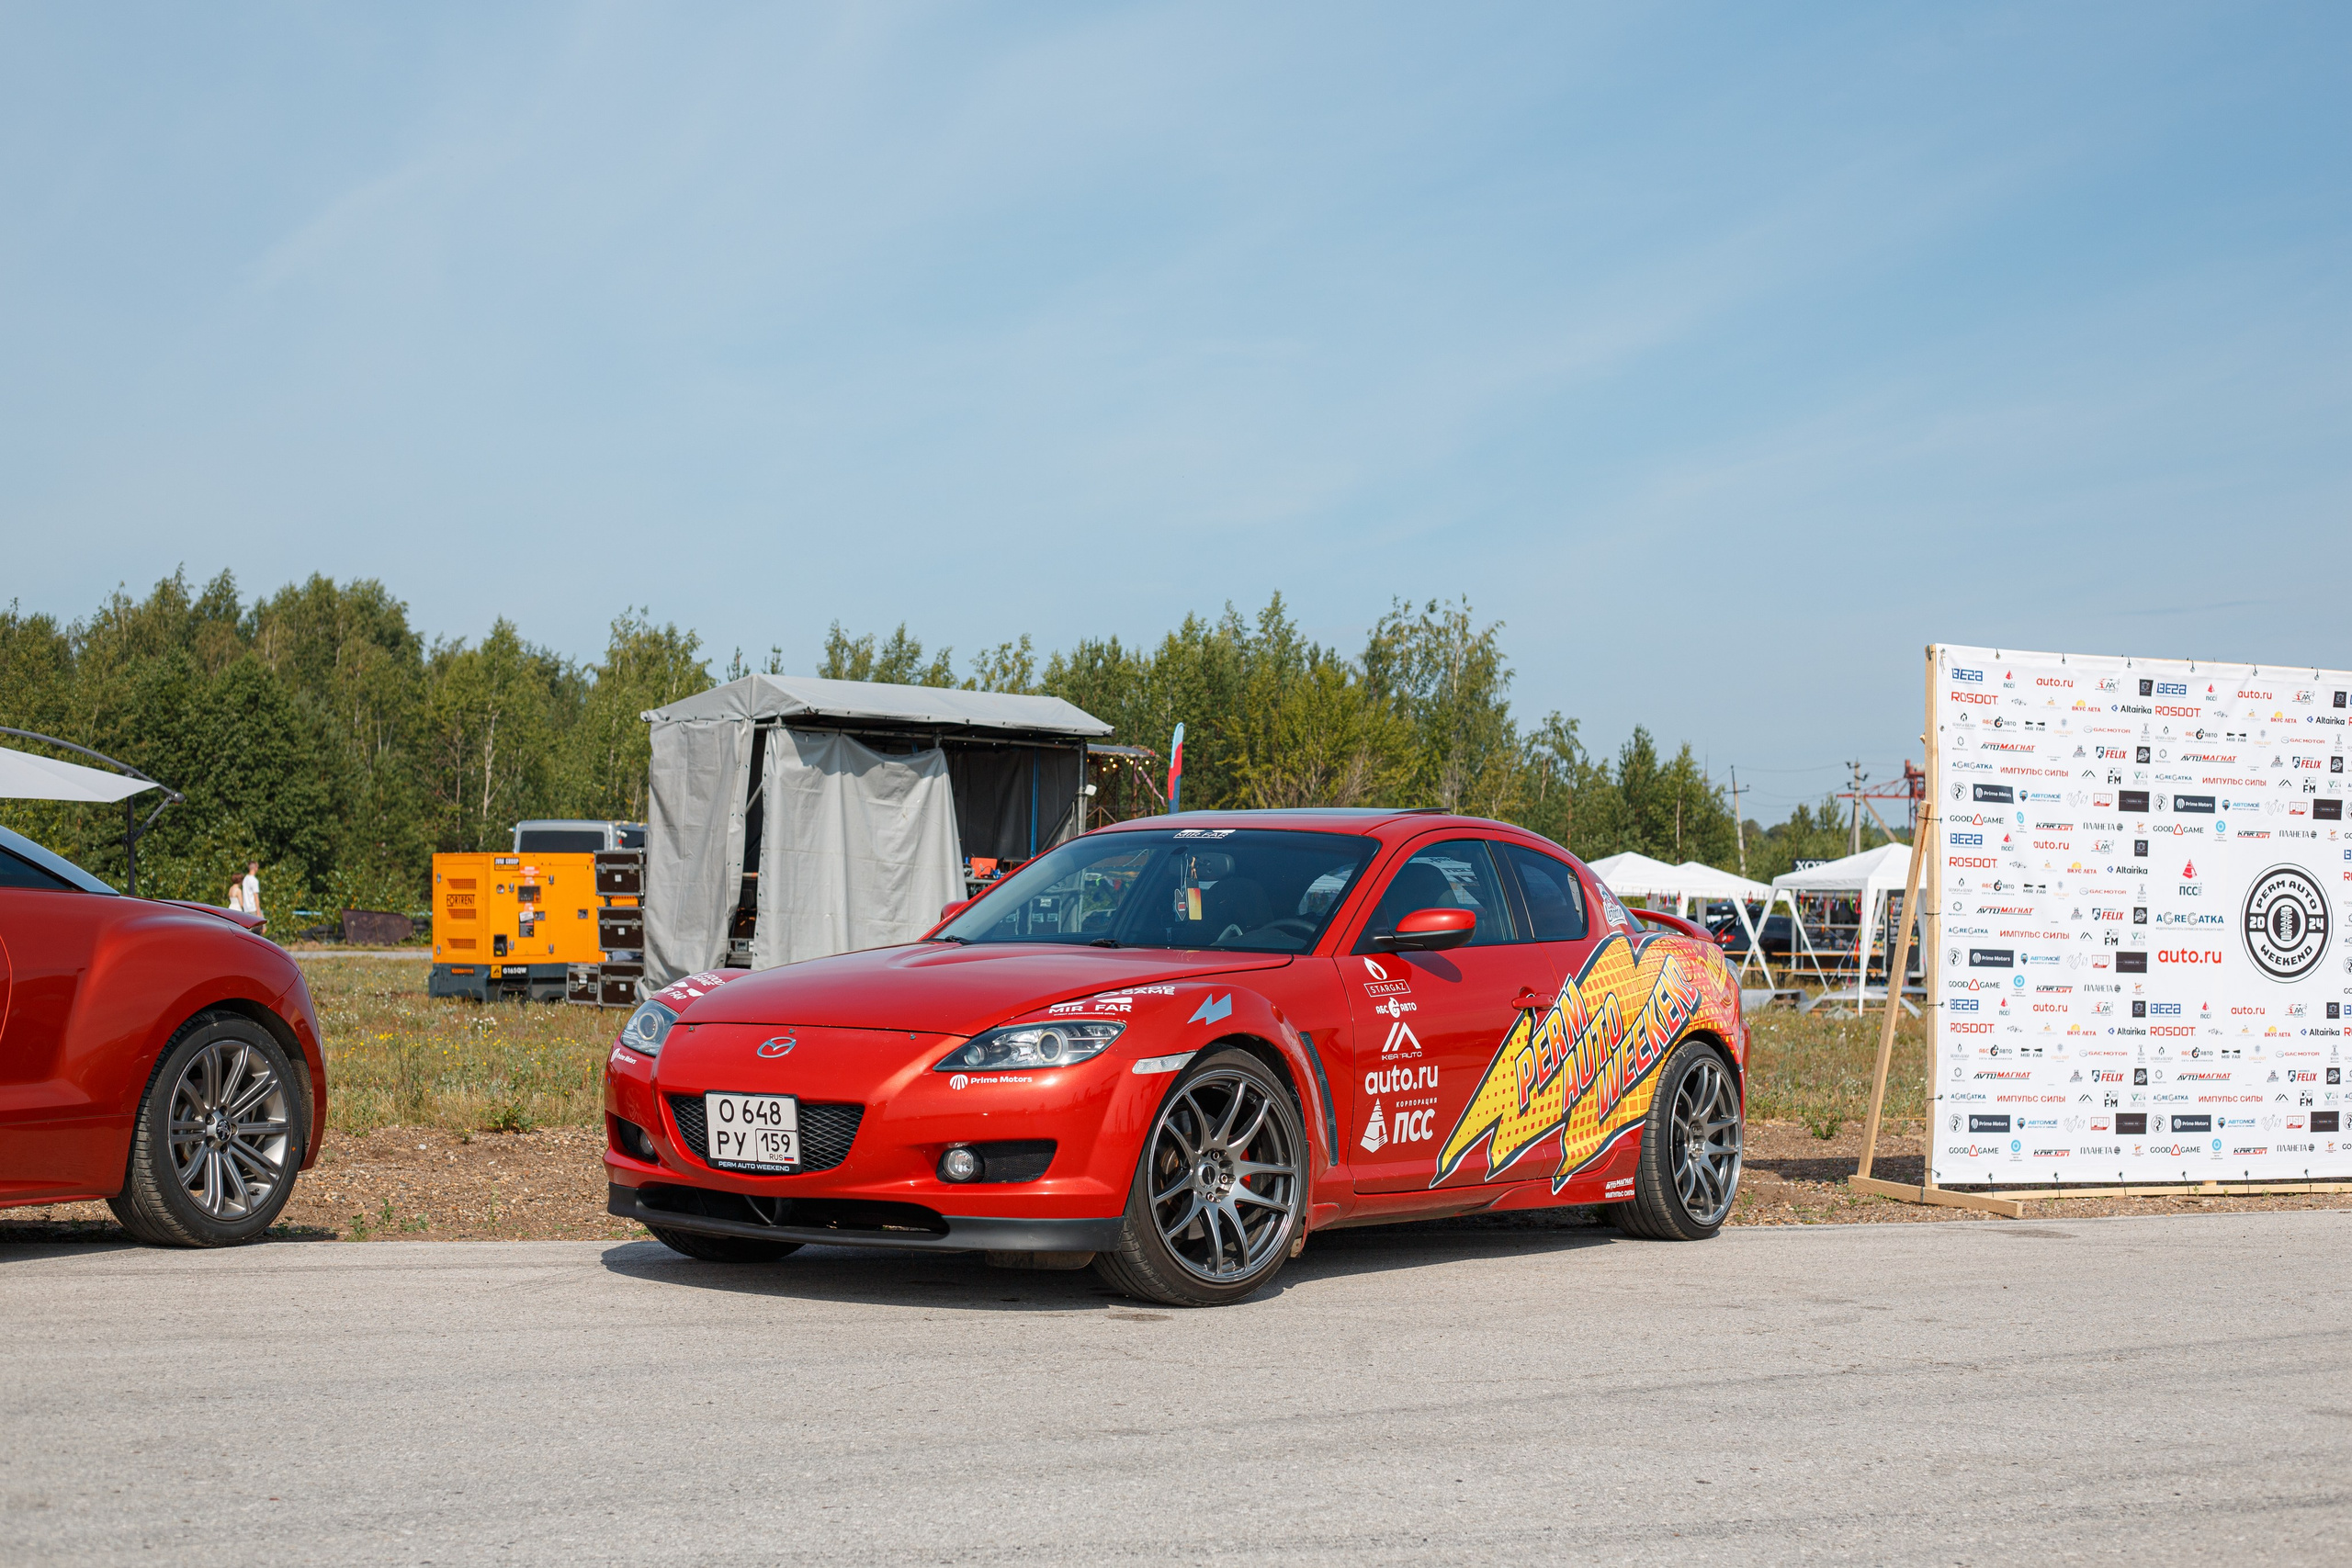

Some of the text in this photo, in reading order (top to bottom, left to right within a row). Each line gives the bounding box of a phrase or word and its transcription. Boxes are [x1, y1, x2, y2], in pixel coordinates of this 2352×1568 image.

[2036, 678, 2074, 687] auto.ru
[2237, 690, 2272, 699] auto.ru
[2120, 705, 2152, 714] Altairika
[2315, 716, 2345, 725] Altairika
[2106, 750, 2127, 759] FELIX
[1952, 761, 1993, 770] AGREGATKA
[2301, 761, 2322, 769] FELIX
[2000, 766, 2043, 775] ИМПУЛЬС
[2045, 769, 2069, 777] СИЛЫ
[2202, 777, 2243, 785] ИМПУЛЬС
[2083, 822, 2115, 830] ПЛАНЕТА
[2033, 840, 2069, 850] auto.ru
[2116, 865, 2148, 874] Altairika
[2256, 880, 2317, 909] PERM AUTO
[2102, 911, 2124, 920] FELIX
[2156, 911, 2224, 926] AGREGATKA
[2249, 916, 2324, 930] 20 24
[2158, 948, 2222, 964] auto.ru
[2260, 944, 2313, 966] WEEKEND
[1369, 982, 1406, 994] STARGAZ
[1049, 1006, 1083, 1014] MIR
[1095, 1004, 1132, 1012] FAR
[1375, 1002, 1417, 1014] АБС АВТО
[2033, 1003, 2067, 1012] auto.ru
[2231, 1007, 2266, 1015] auto.ru
[2117, 1027, 2146, 1036] Altairika
[2310, 1028, 2340, 1036] Altairika
[1516, 974, 1589, 1111] PERM
[1597, 955, 1699, 1121] WEEKEND
[1562, 992, 1624, 1113] AUTO
[1364, 1065, 1438, 1095] auto.ru
[2101, 1073, 2124, 1082] FELIX
[2297, 1073, 2317, 1081] FELIX
[1396, 1097, 1438, 1108] КОРПОРАЦИЯ
[719, 1099, 781, 1125] О 648
[1393, 1108, 1435, 1144] ПСС
[717, 1130, 790, 1156] РУ 159
[2080, 1146, 2112, 1155] ПЛАНЕТА
